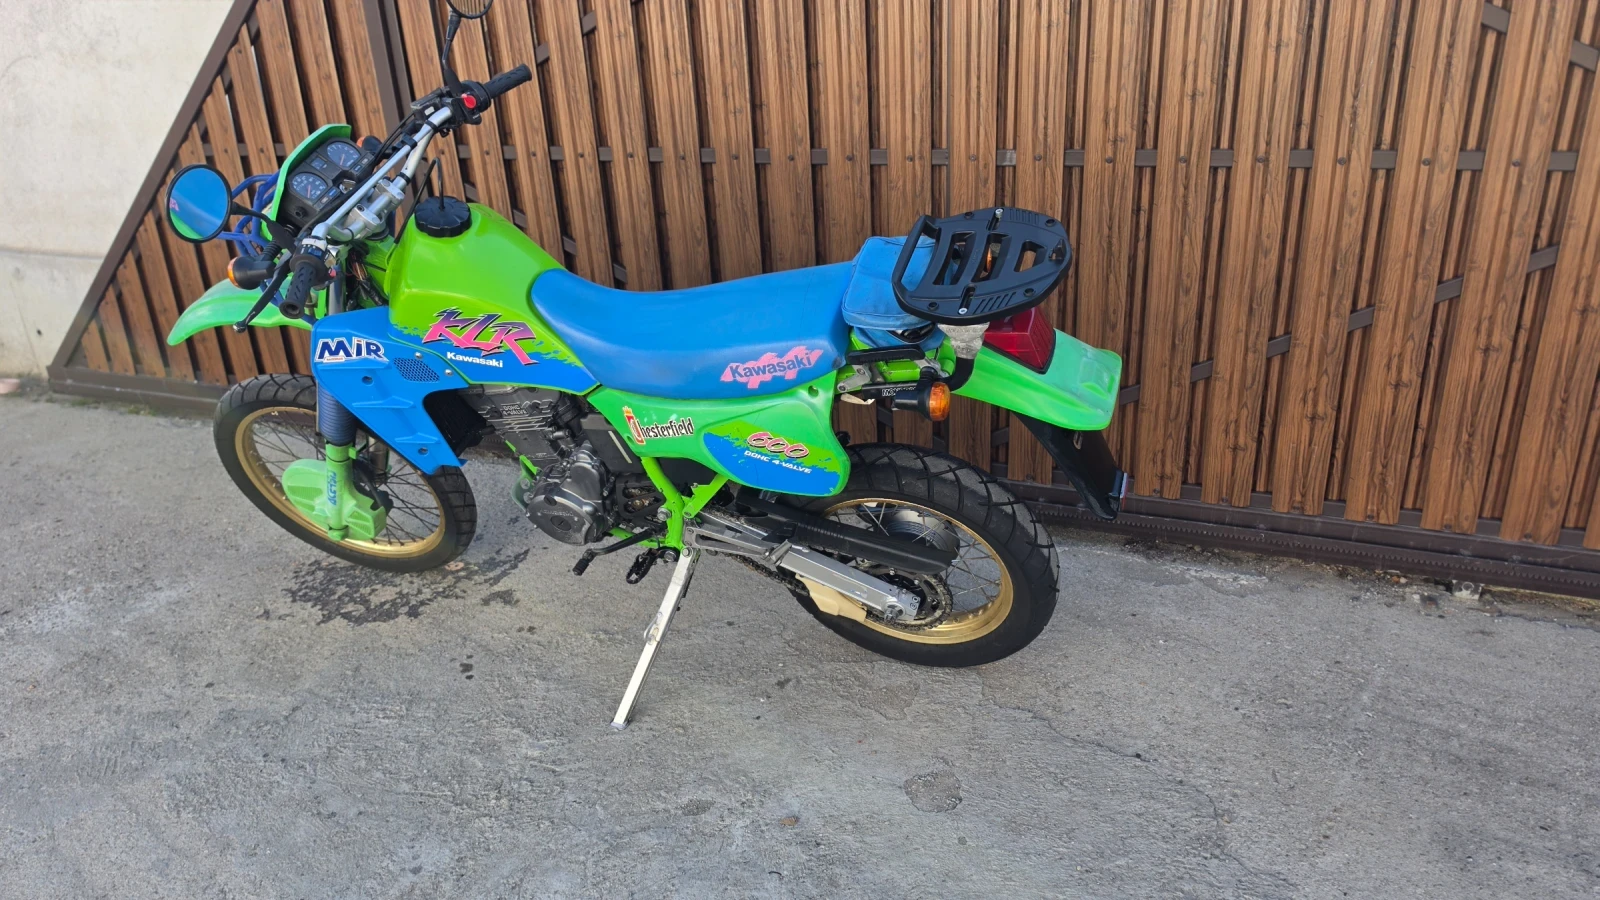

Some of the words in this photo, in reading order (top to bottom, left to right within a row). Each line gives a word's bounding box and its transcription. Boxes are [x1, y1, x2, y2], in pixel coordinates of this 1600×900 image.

[423, 307, 538, 365] KLR
[447, 352, 503, 368] Kawasaki
[729, 351, 812, 379] Kawasaki
[623, 408, 694, 445] Chesterfield
[747, 431, 810, 459] 600
[744, 450, 770, 463] DOHC
[772, 460, 812, 474] 4-VALVE
